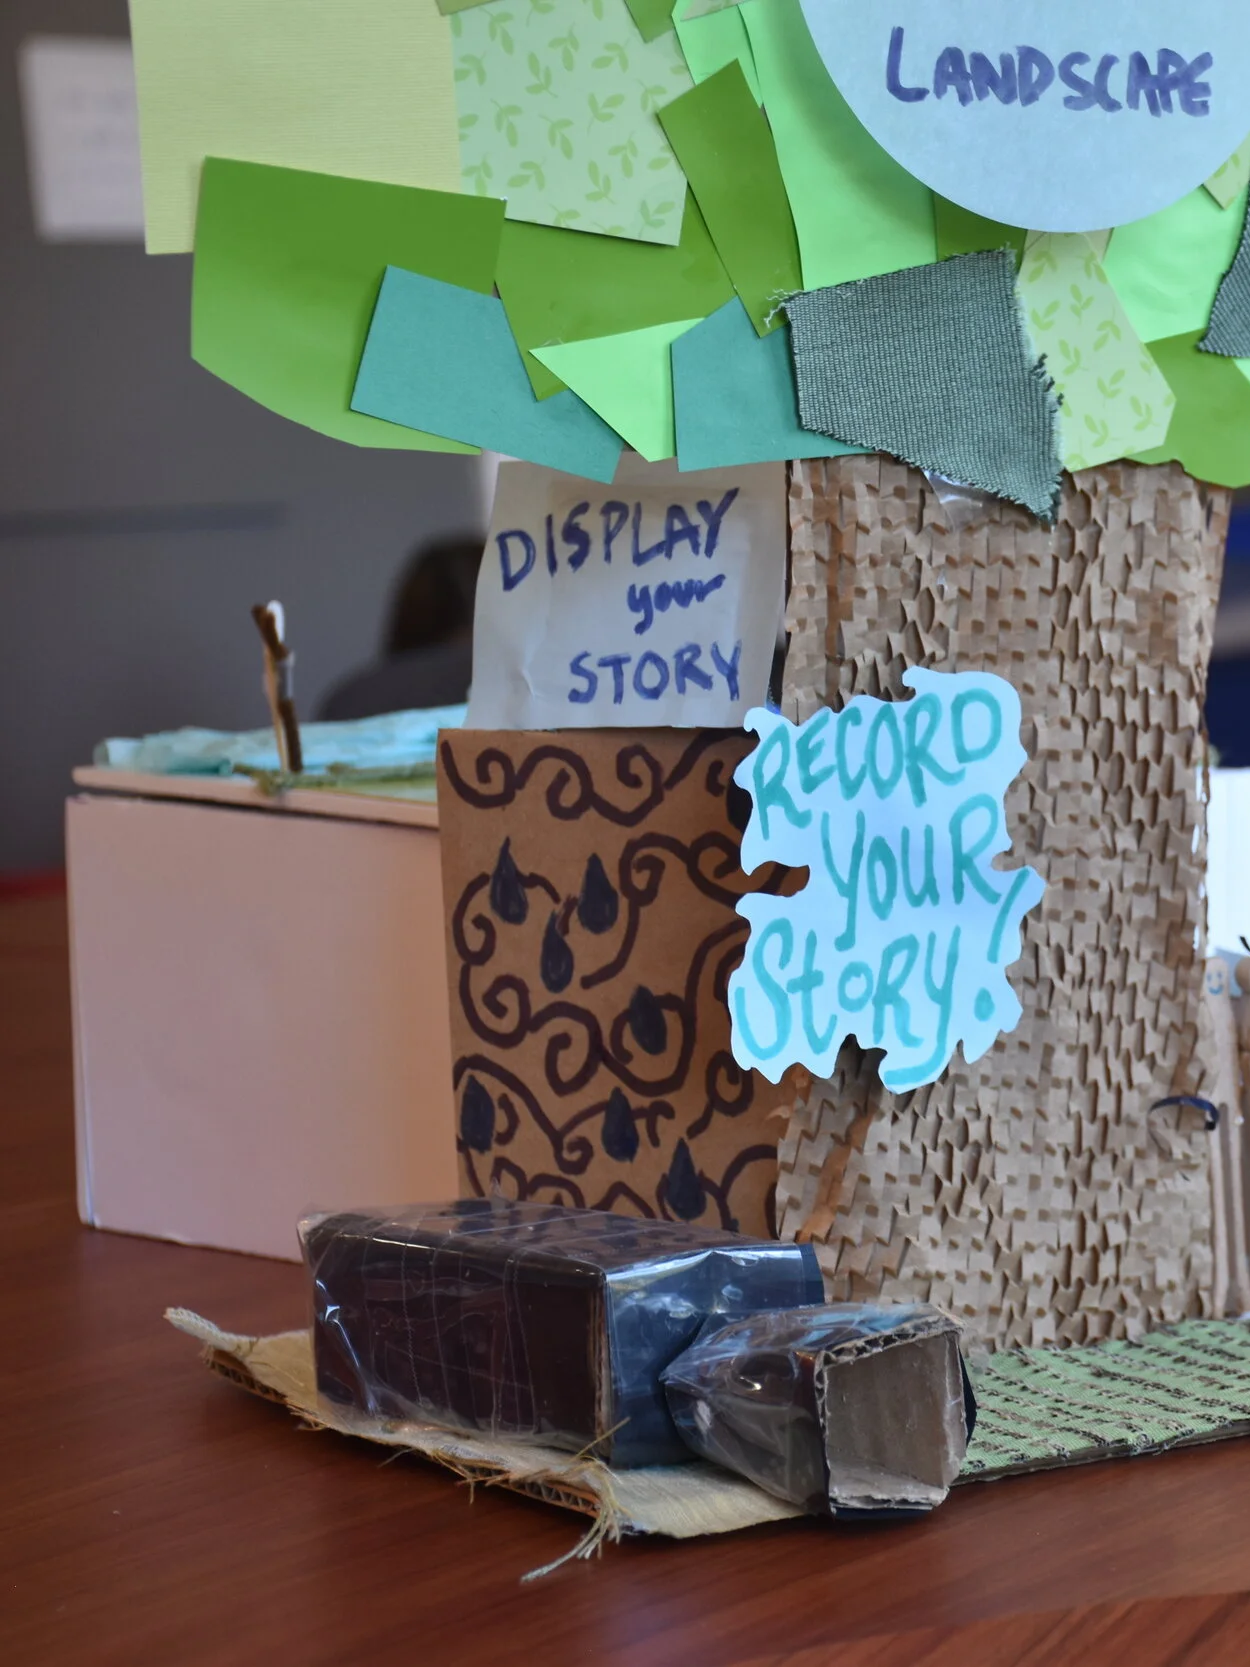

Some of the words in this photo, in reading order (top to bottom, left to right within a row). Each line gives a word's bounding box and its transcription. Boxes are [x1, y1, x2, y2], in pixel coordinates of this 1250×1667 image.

[886, 26, 1214, 117] LANDSCAPE
[495, 487, 740, 592] DISPLAY
[627, 573, 727, 634] your
[568, 640, 743, 705] STORY
[751, 687, 1004, 839] RECORD
[819, 792, 1001, 952] YOUR
